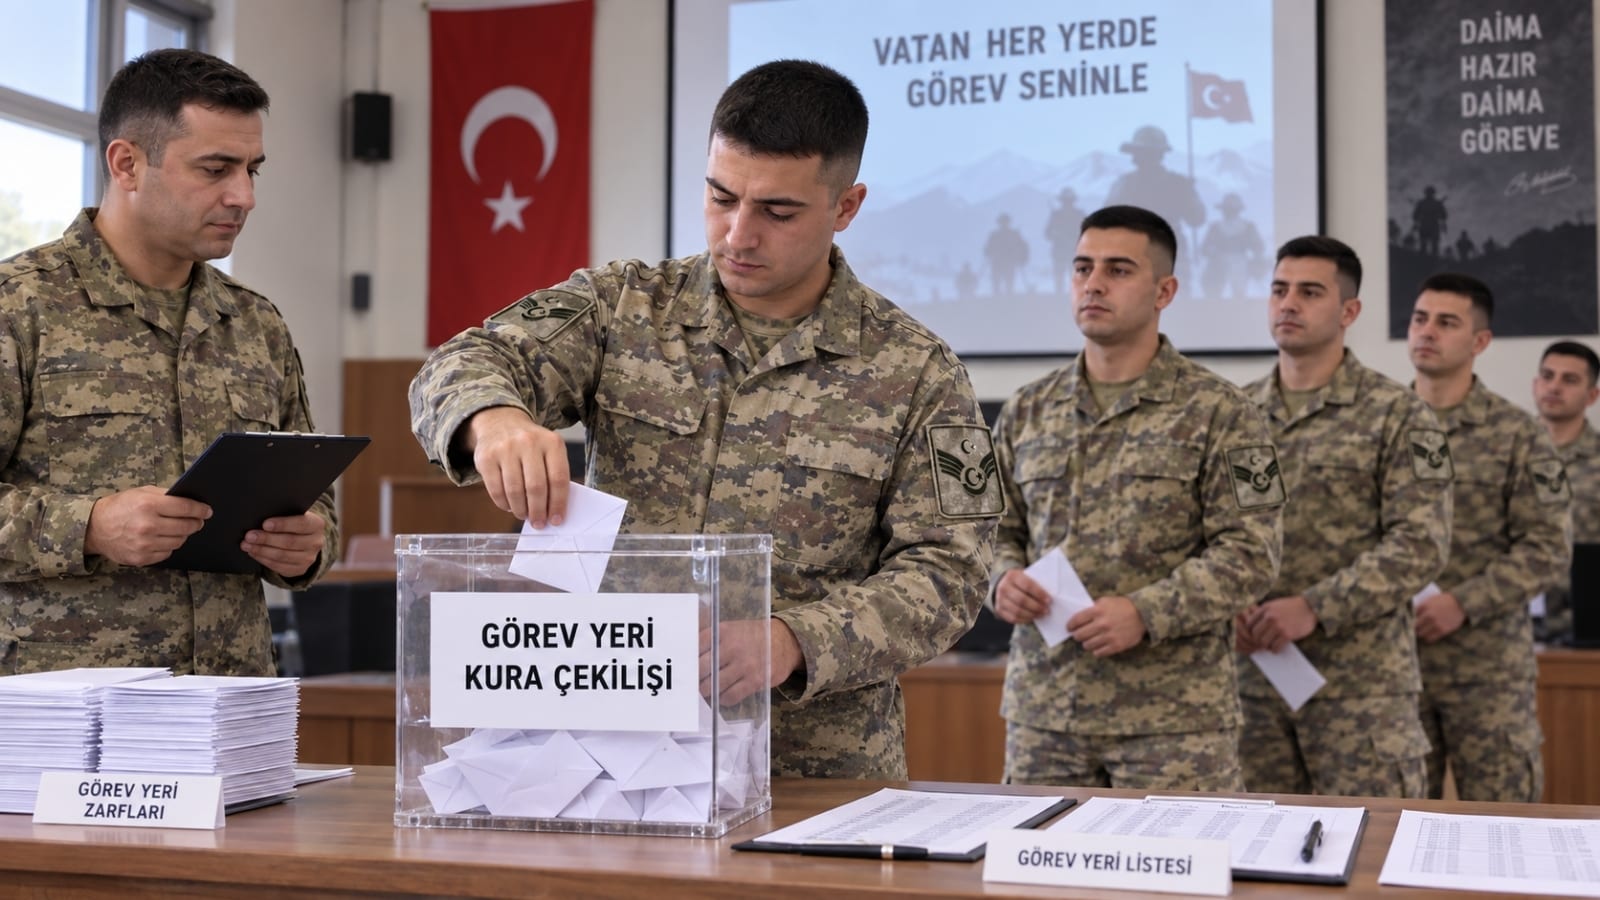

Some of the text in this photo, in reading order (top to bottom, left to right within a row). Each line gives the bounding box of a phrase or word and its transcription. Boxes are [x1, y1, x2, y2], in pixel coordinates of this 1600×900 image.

[874, 16, 1157, 66] VATAN HER YERDE
[1460, 11, 1542, 44] DAİMA
[1460, 51, 1536, 81] HAZIR
[907, 60, 1148, 108] GÖREV SENİNLE
[1461, 84, 1544, 117] DAİMA
[1460, 122, 1560, 154] GÖREVE
[481, 617, 654, 649] GÖREV YERİ
[465, 658, 672, 697] KURA ÇEKİLİŞİ
[78, 779, 178, 800] GÖREV YERİ
[84, 803, 165, 820] ZARFLARI
[1017, 846, 1192, 876] GÖREV YERİ LİSTESİ
